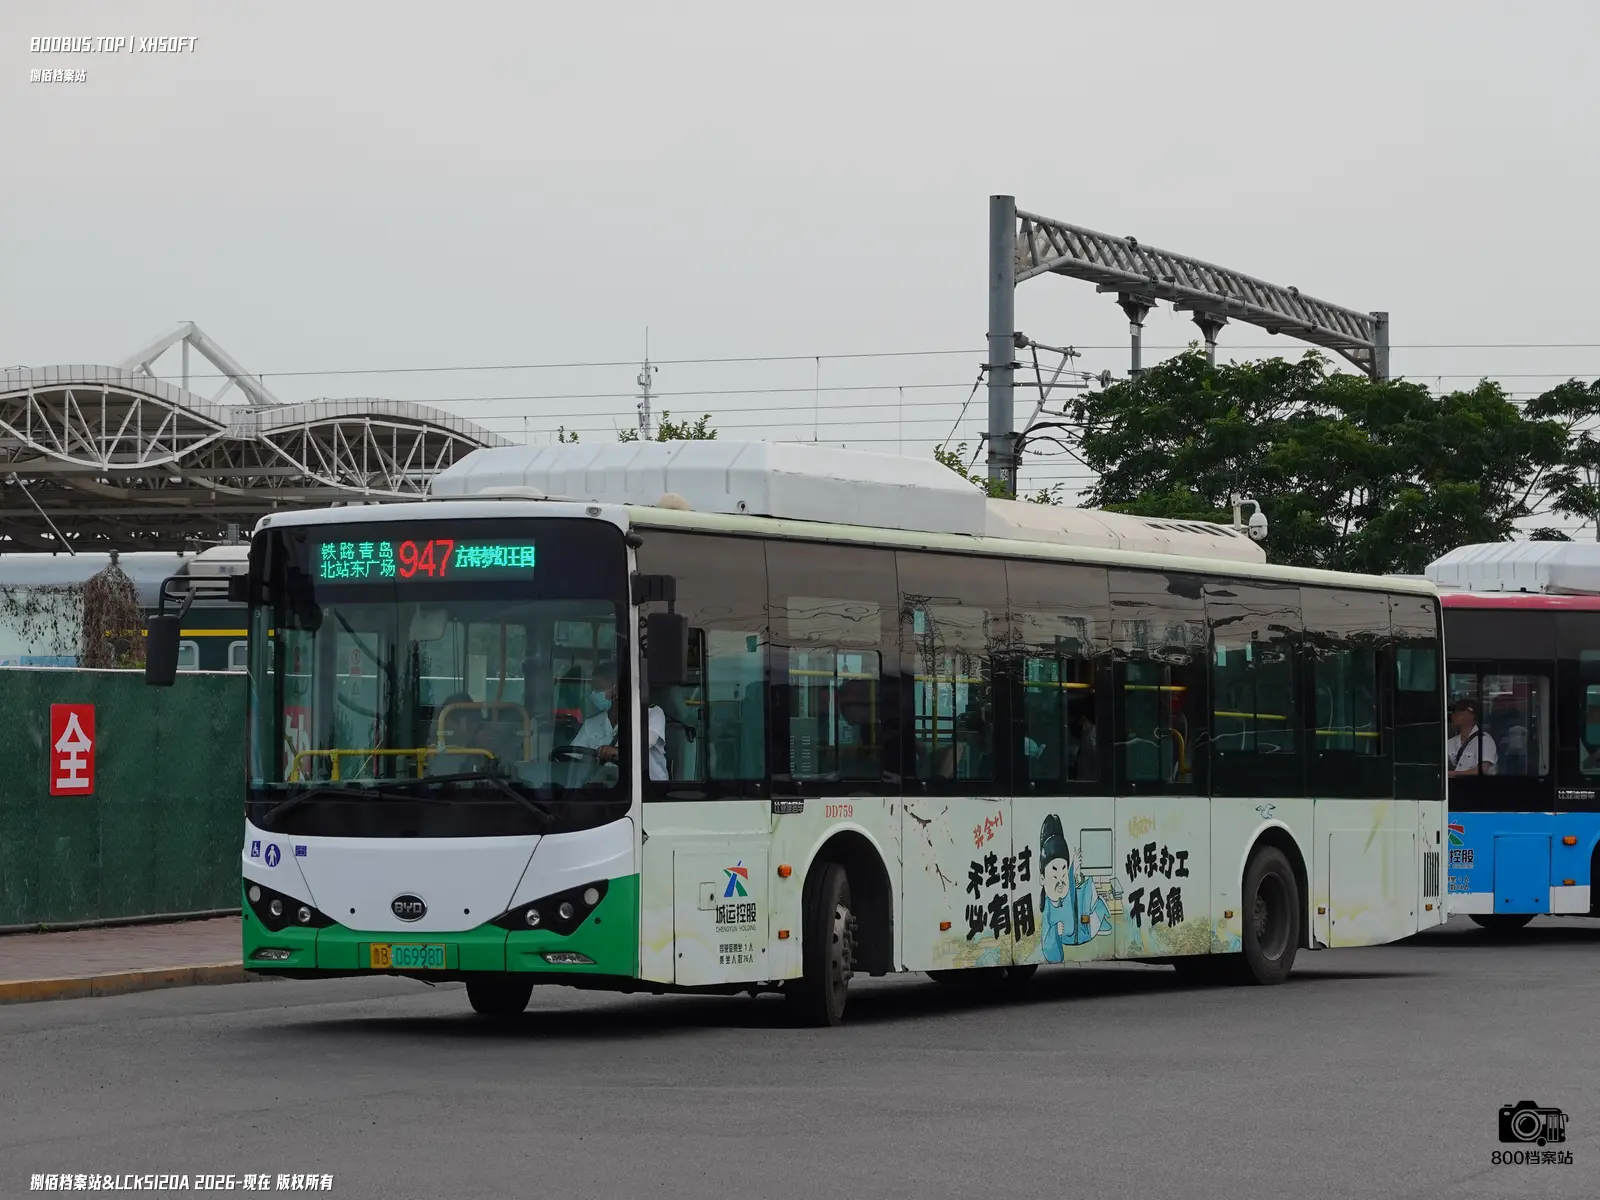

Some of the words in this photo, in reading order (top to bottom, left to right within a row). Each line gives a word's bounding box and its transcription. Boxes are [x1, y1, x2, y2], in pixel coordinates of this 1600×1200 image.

[321, 541, 393, 560] 铁路青岛
[399, 539, 454, 578] 947
[320, 559, 396, 578] 北站东广场
[55, 711, 92, 788] 全
[825, 804, 854, 818] DD759
[1125, 841, 1190, 883] 快乐打工
[394, 902, 422, 913] BYD
[715, 903, 757, 924] 城运控股
[965, 893, 1036, 943] 必有用
[1128, 887, 1184, 928] 不会痛
